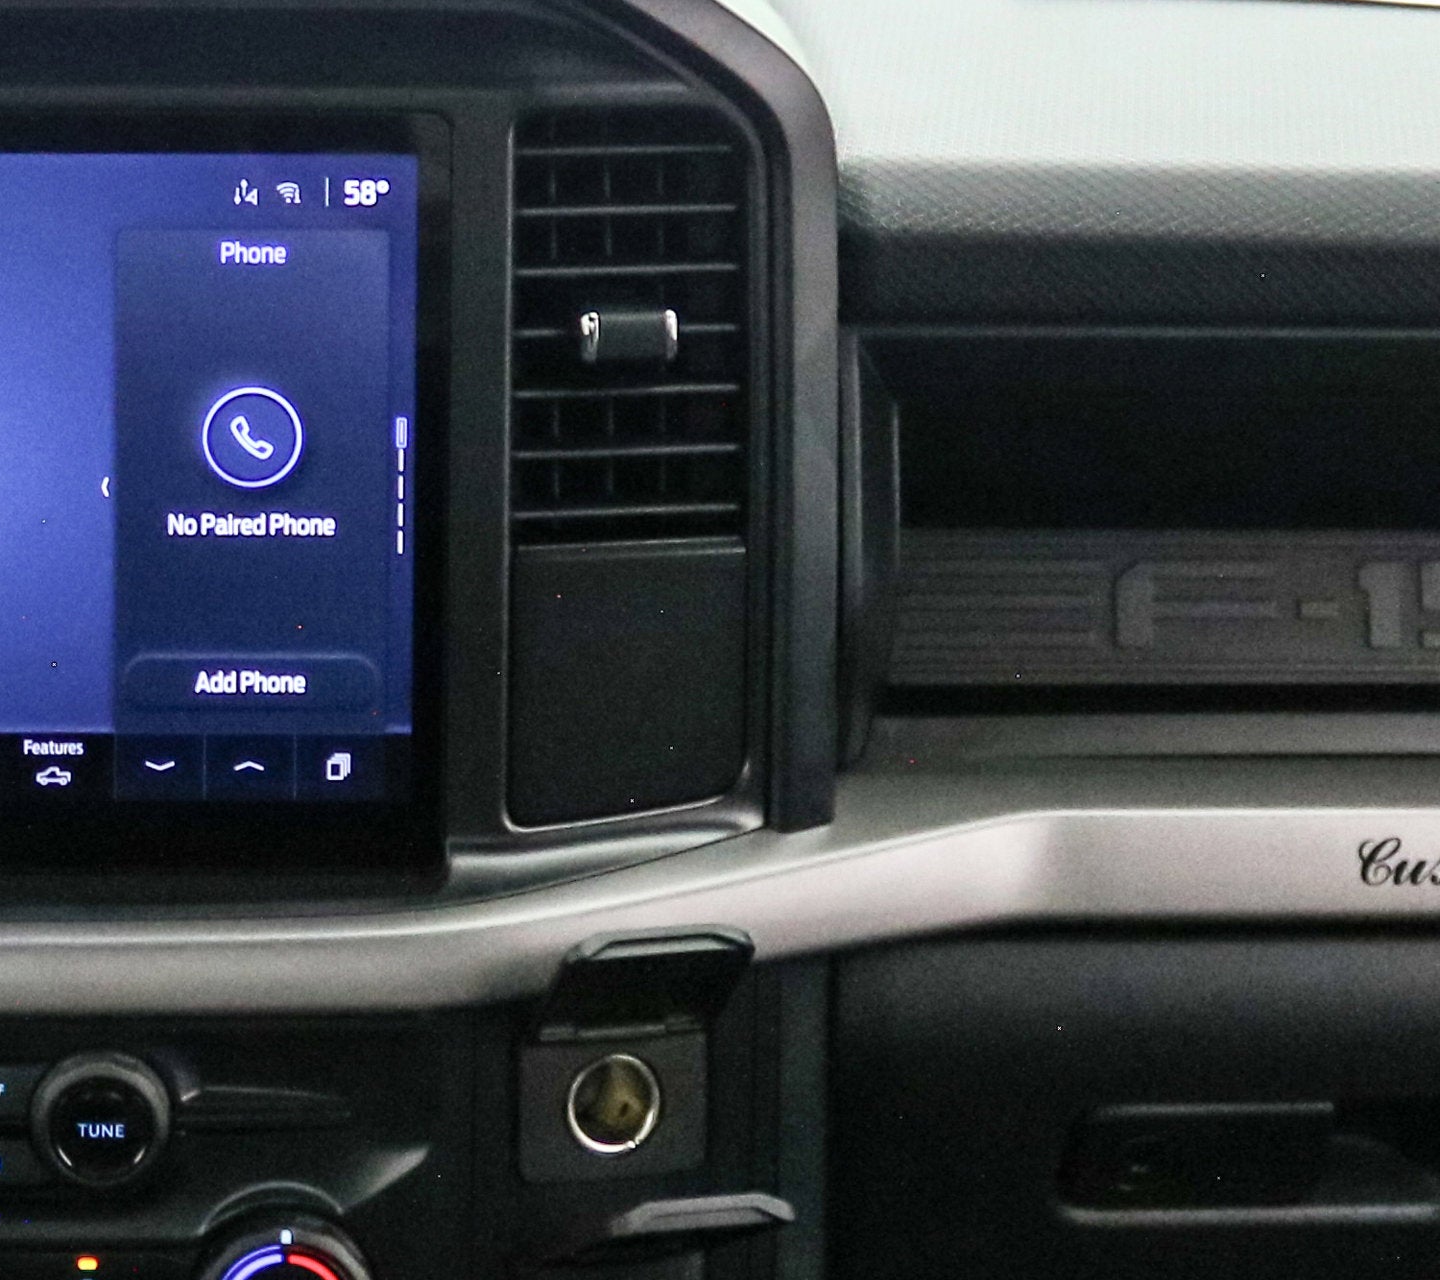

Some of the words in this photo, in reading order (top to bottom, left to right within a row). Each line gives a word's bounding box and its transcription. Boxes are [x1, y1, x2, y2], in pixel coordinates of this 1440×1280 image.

[219, 241, 287, 265] Phone
[166, 513, 197, 537] No
[200, 513, 266, 537] Paired
[268, 513, 336, 537] Phone
[194, 670, 237, 694] Add
[239, 670, 307, 694] Phone
[23, 738, 84, 756] Features
[77, 1123, 124, 1138] TUNE
